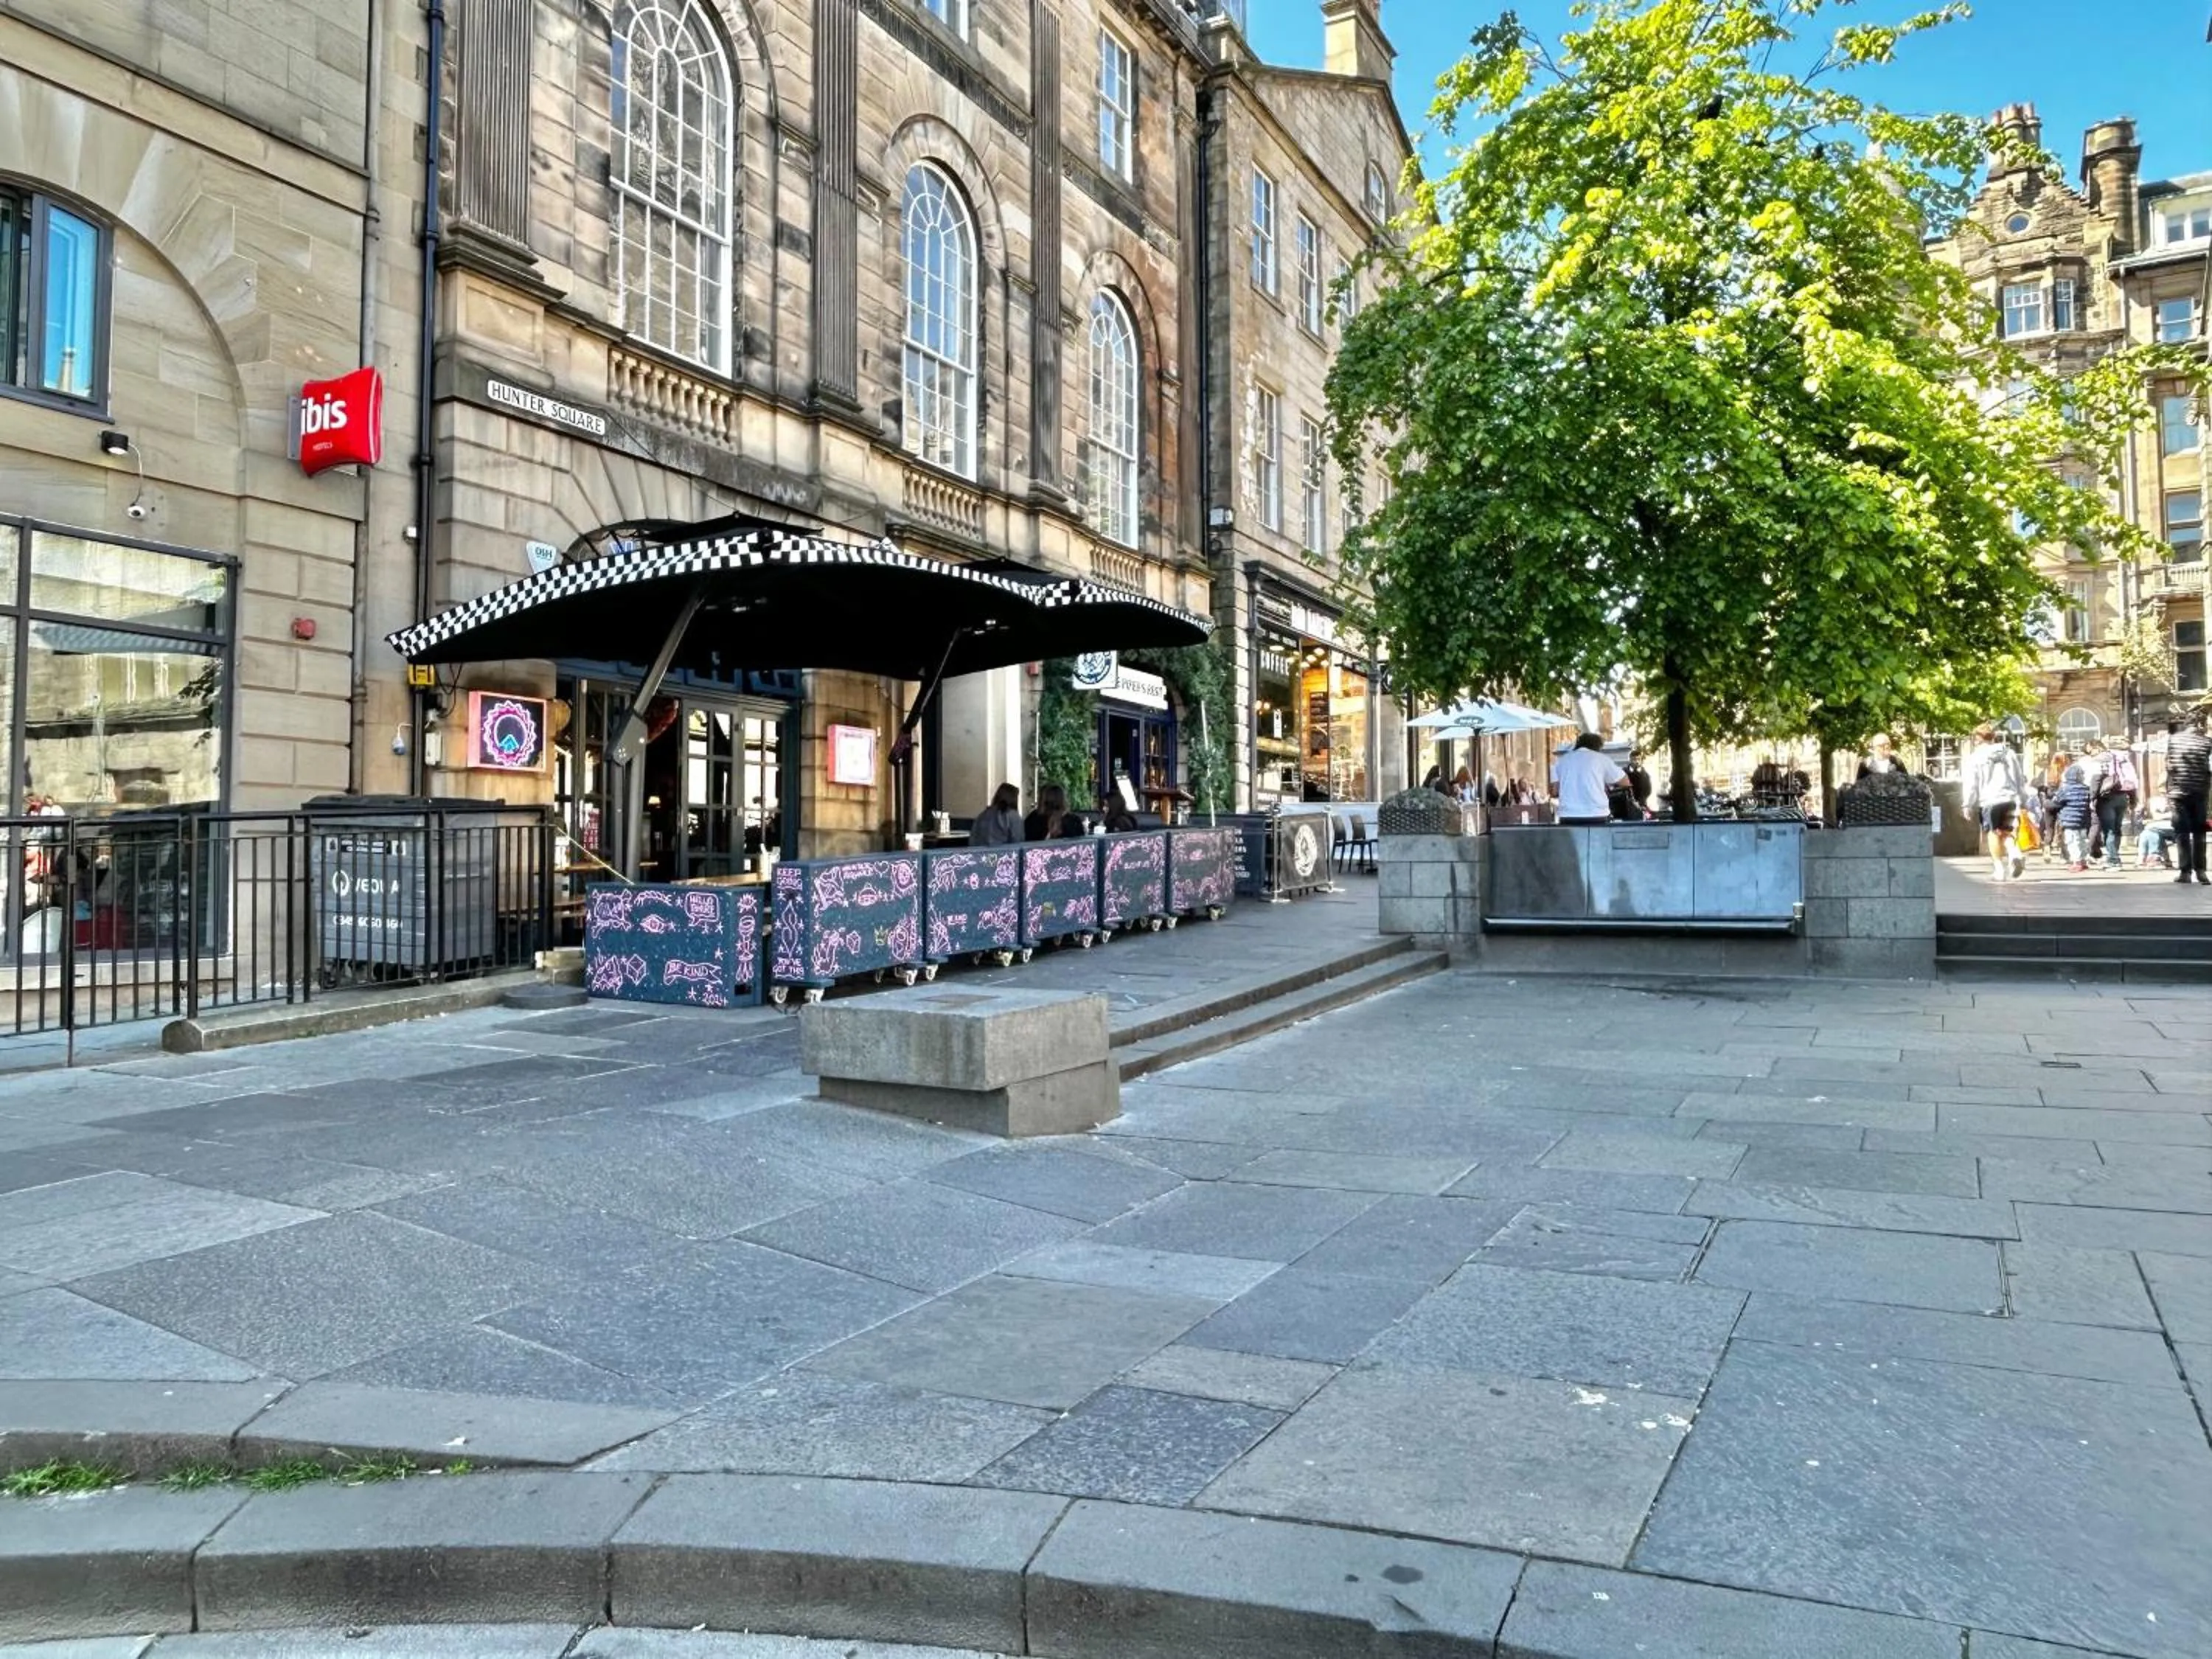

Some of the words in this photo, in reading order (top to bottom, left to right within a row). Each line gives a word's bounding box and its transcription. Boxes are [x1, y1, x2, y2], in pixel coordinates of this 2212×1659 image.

[301, 393, 347, 436] ibis
[492, 383, 546, 413] HUNTER
[552, 403, 602, 433] SQUARE
[776, 868, 801, 876] KEEP
[351, 877, 399, 894] VEOLA
[689, 895, 714, 905] HELLO
[669, 963, 682, 974] BE
[684, 965, 709, 977] KIND
